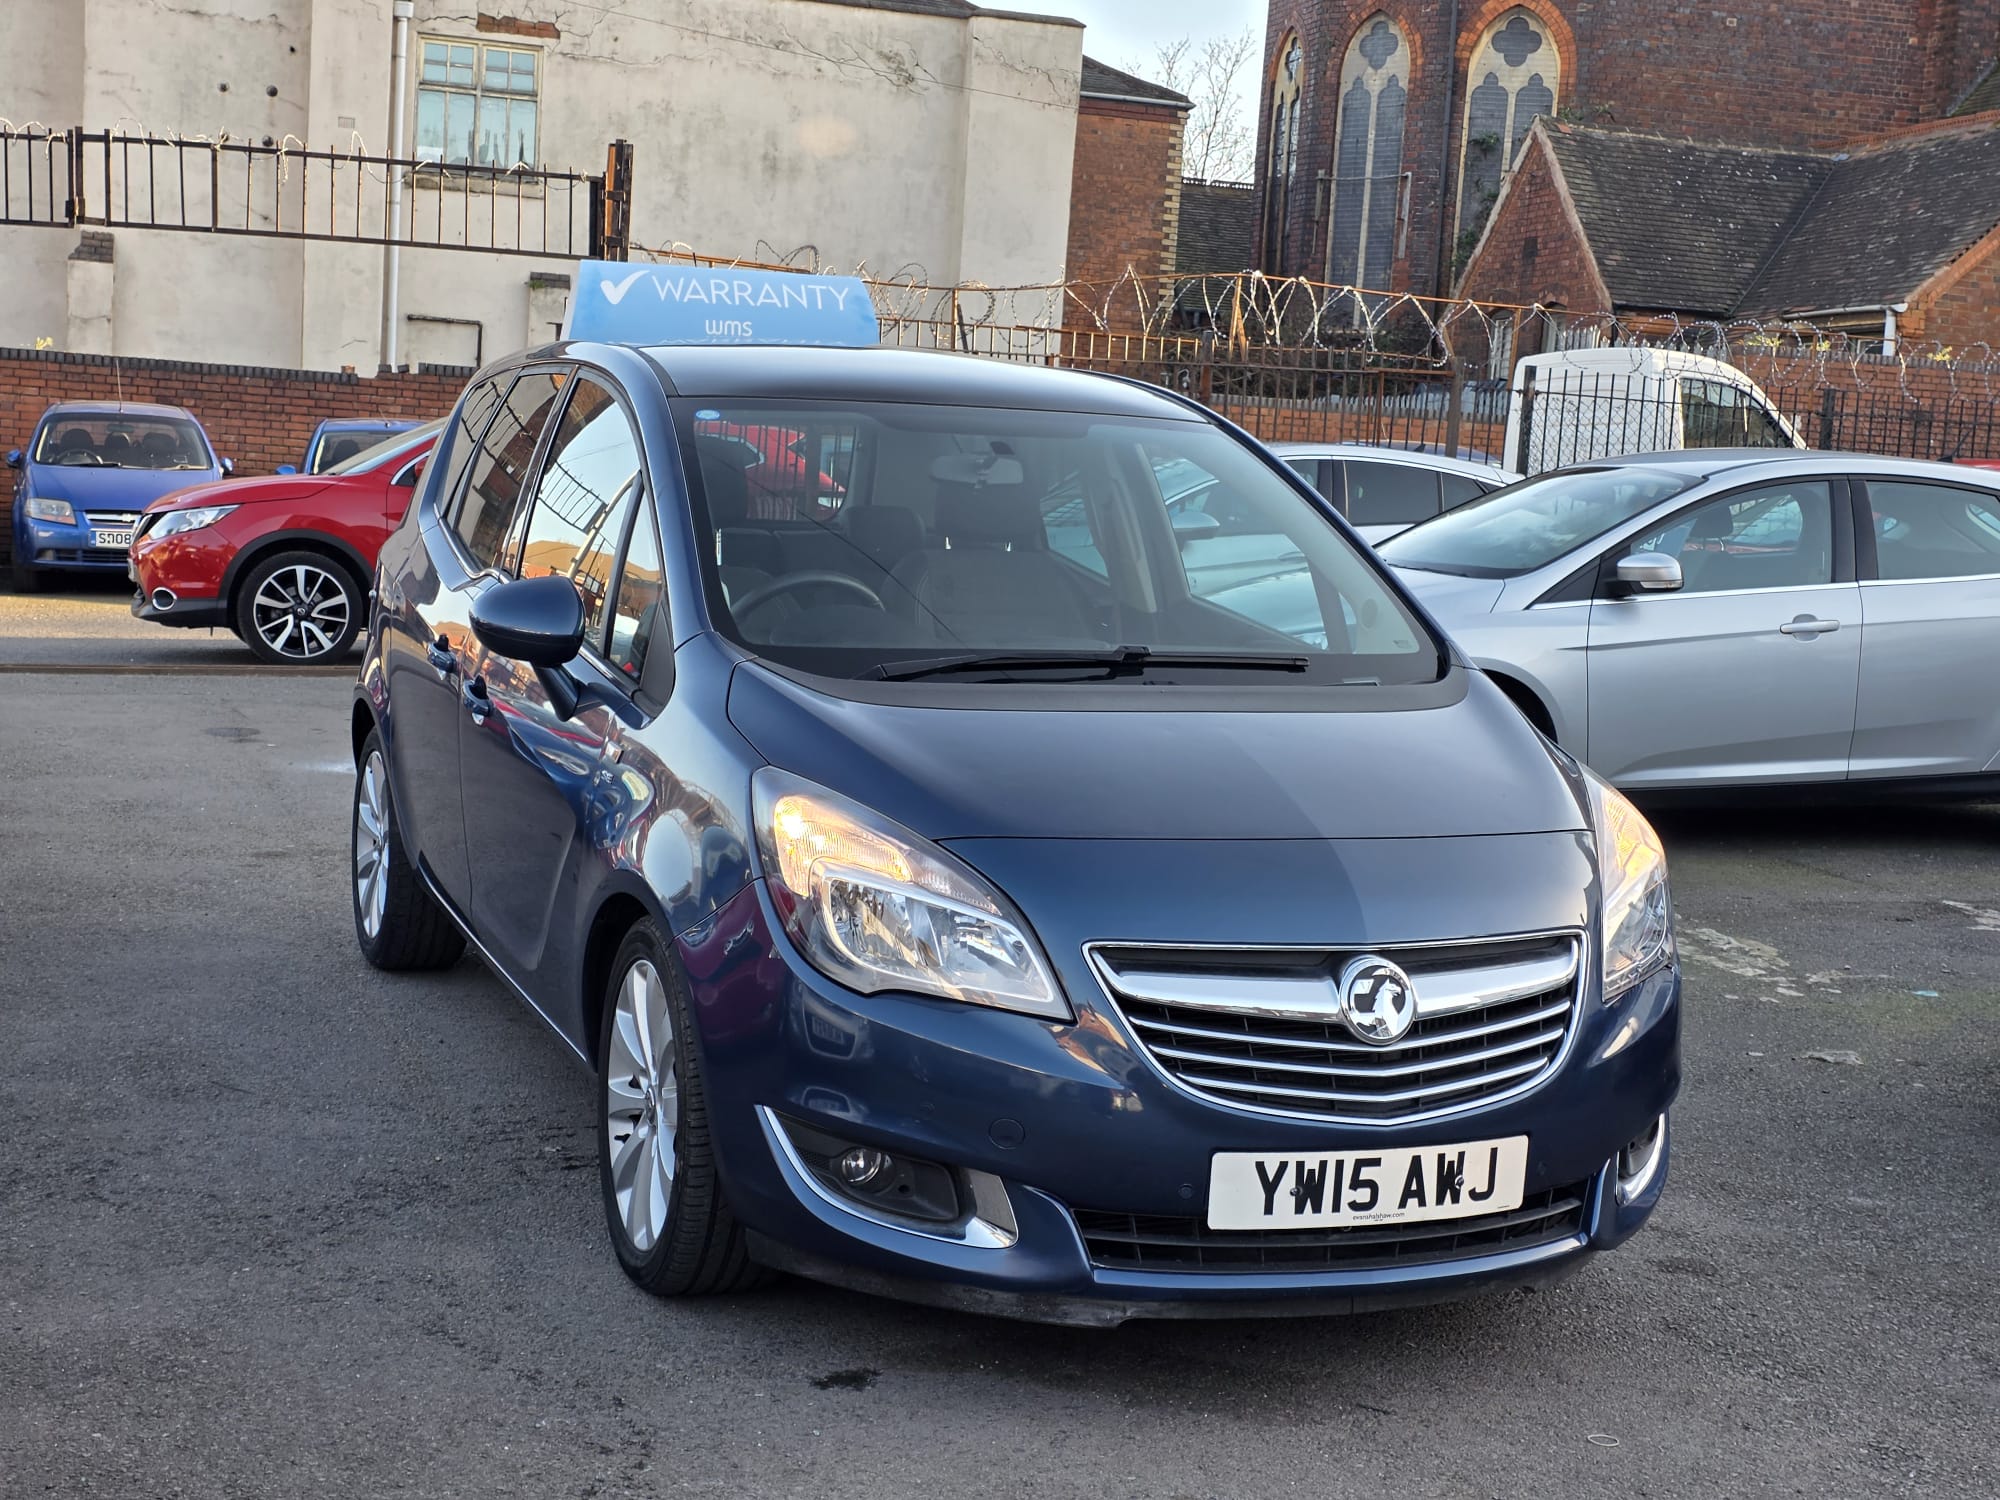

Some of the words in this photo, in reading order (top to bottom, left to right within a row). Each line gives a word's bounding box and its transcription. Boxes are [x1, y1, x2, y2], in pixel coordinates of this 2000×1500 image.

[651, 275, 849, 311] WARRANTY
[705, 319, 753, 337] wms
[1255, 1157, 1382, 1216] YW15
[1397, 1147, 1499, 1210] AWJ
[1352, 1212, 1405, 1221] evanshalshaw.com
